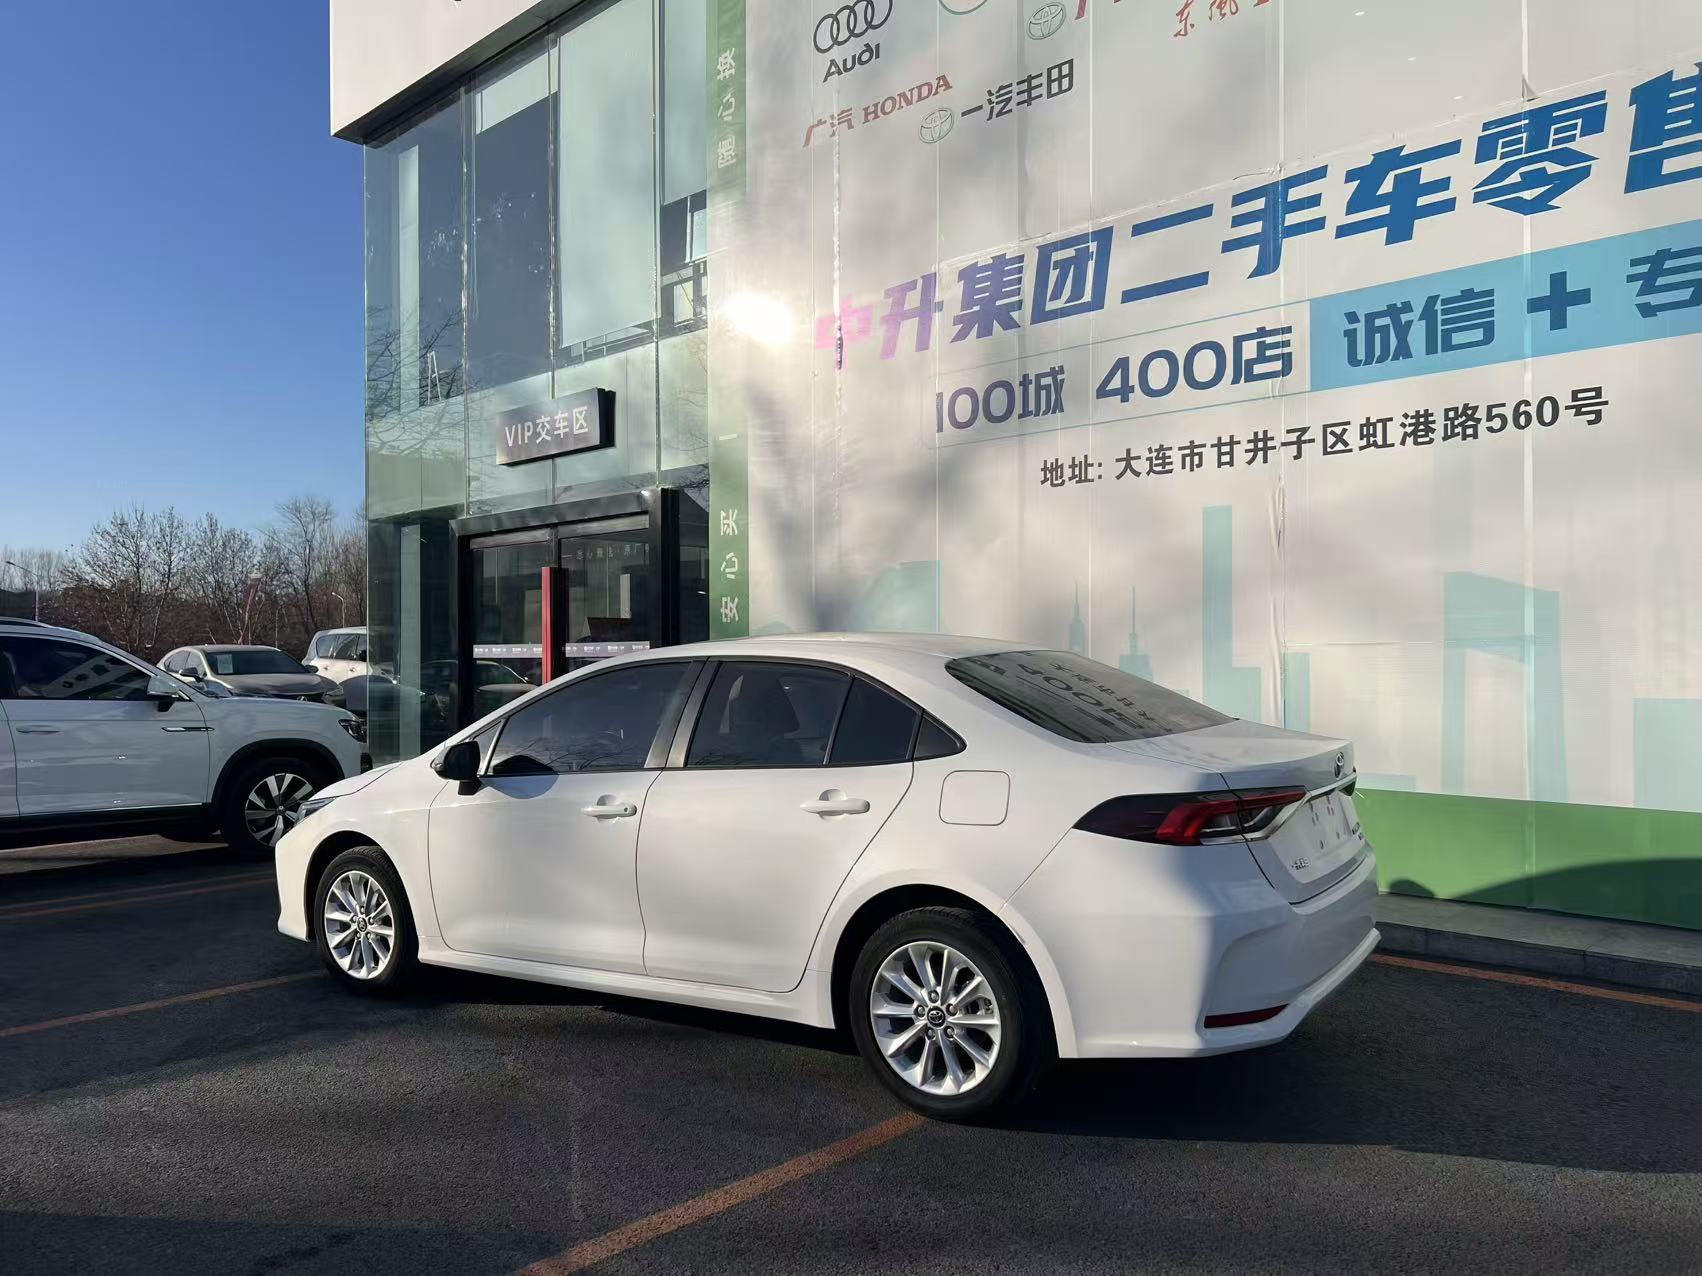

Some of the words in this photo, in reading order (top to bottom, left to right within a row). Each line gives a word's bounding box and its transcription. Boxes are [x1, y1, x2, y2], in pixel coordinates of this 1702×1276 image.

[822, 43, 881, 83] Audi
[961, 58, 1074, 122] 一汽丰田
[802, 107, 855, 148] 广汽
[862, 74, 953, 125] HONDA
[1343, 287, 1495, 368] 诚信
[936, 364, 1065, 434] 100城
[1095, 325, 1293, 403] 400店
[504, 406, 589, 447] VIP交车区
[720, 508, 739, 624] 安心买
